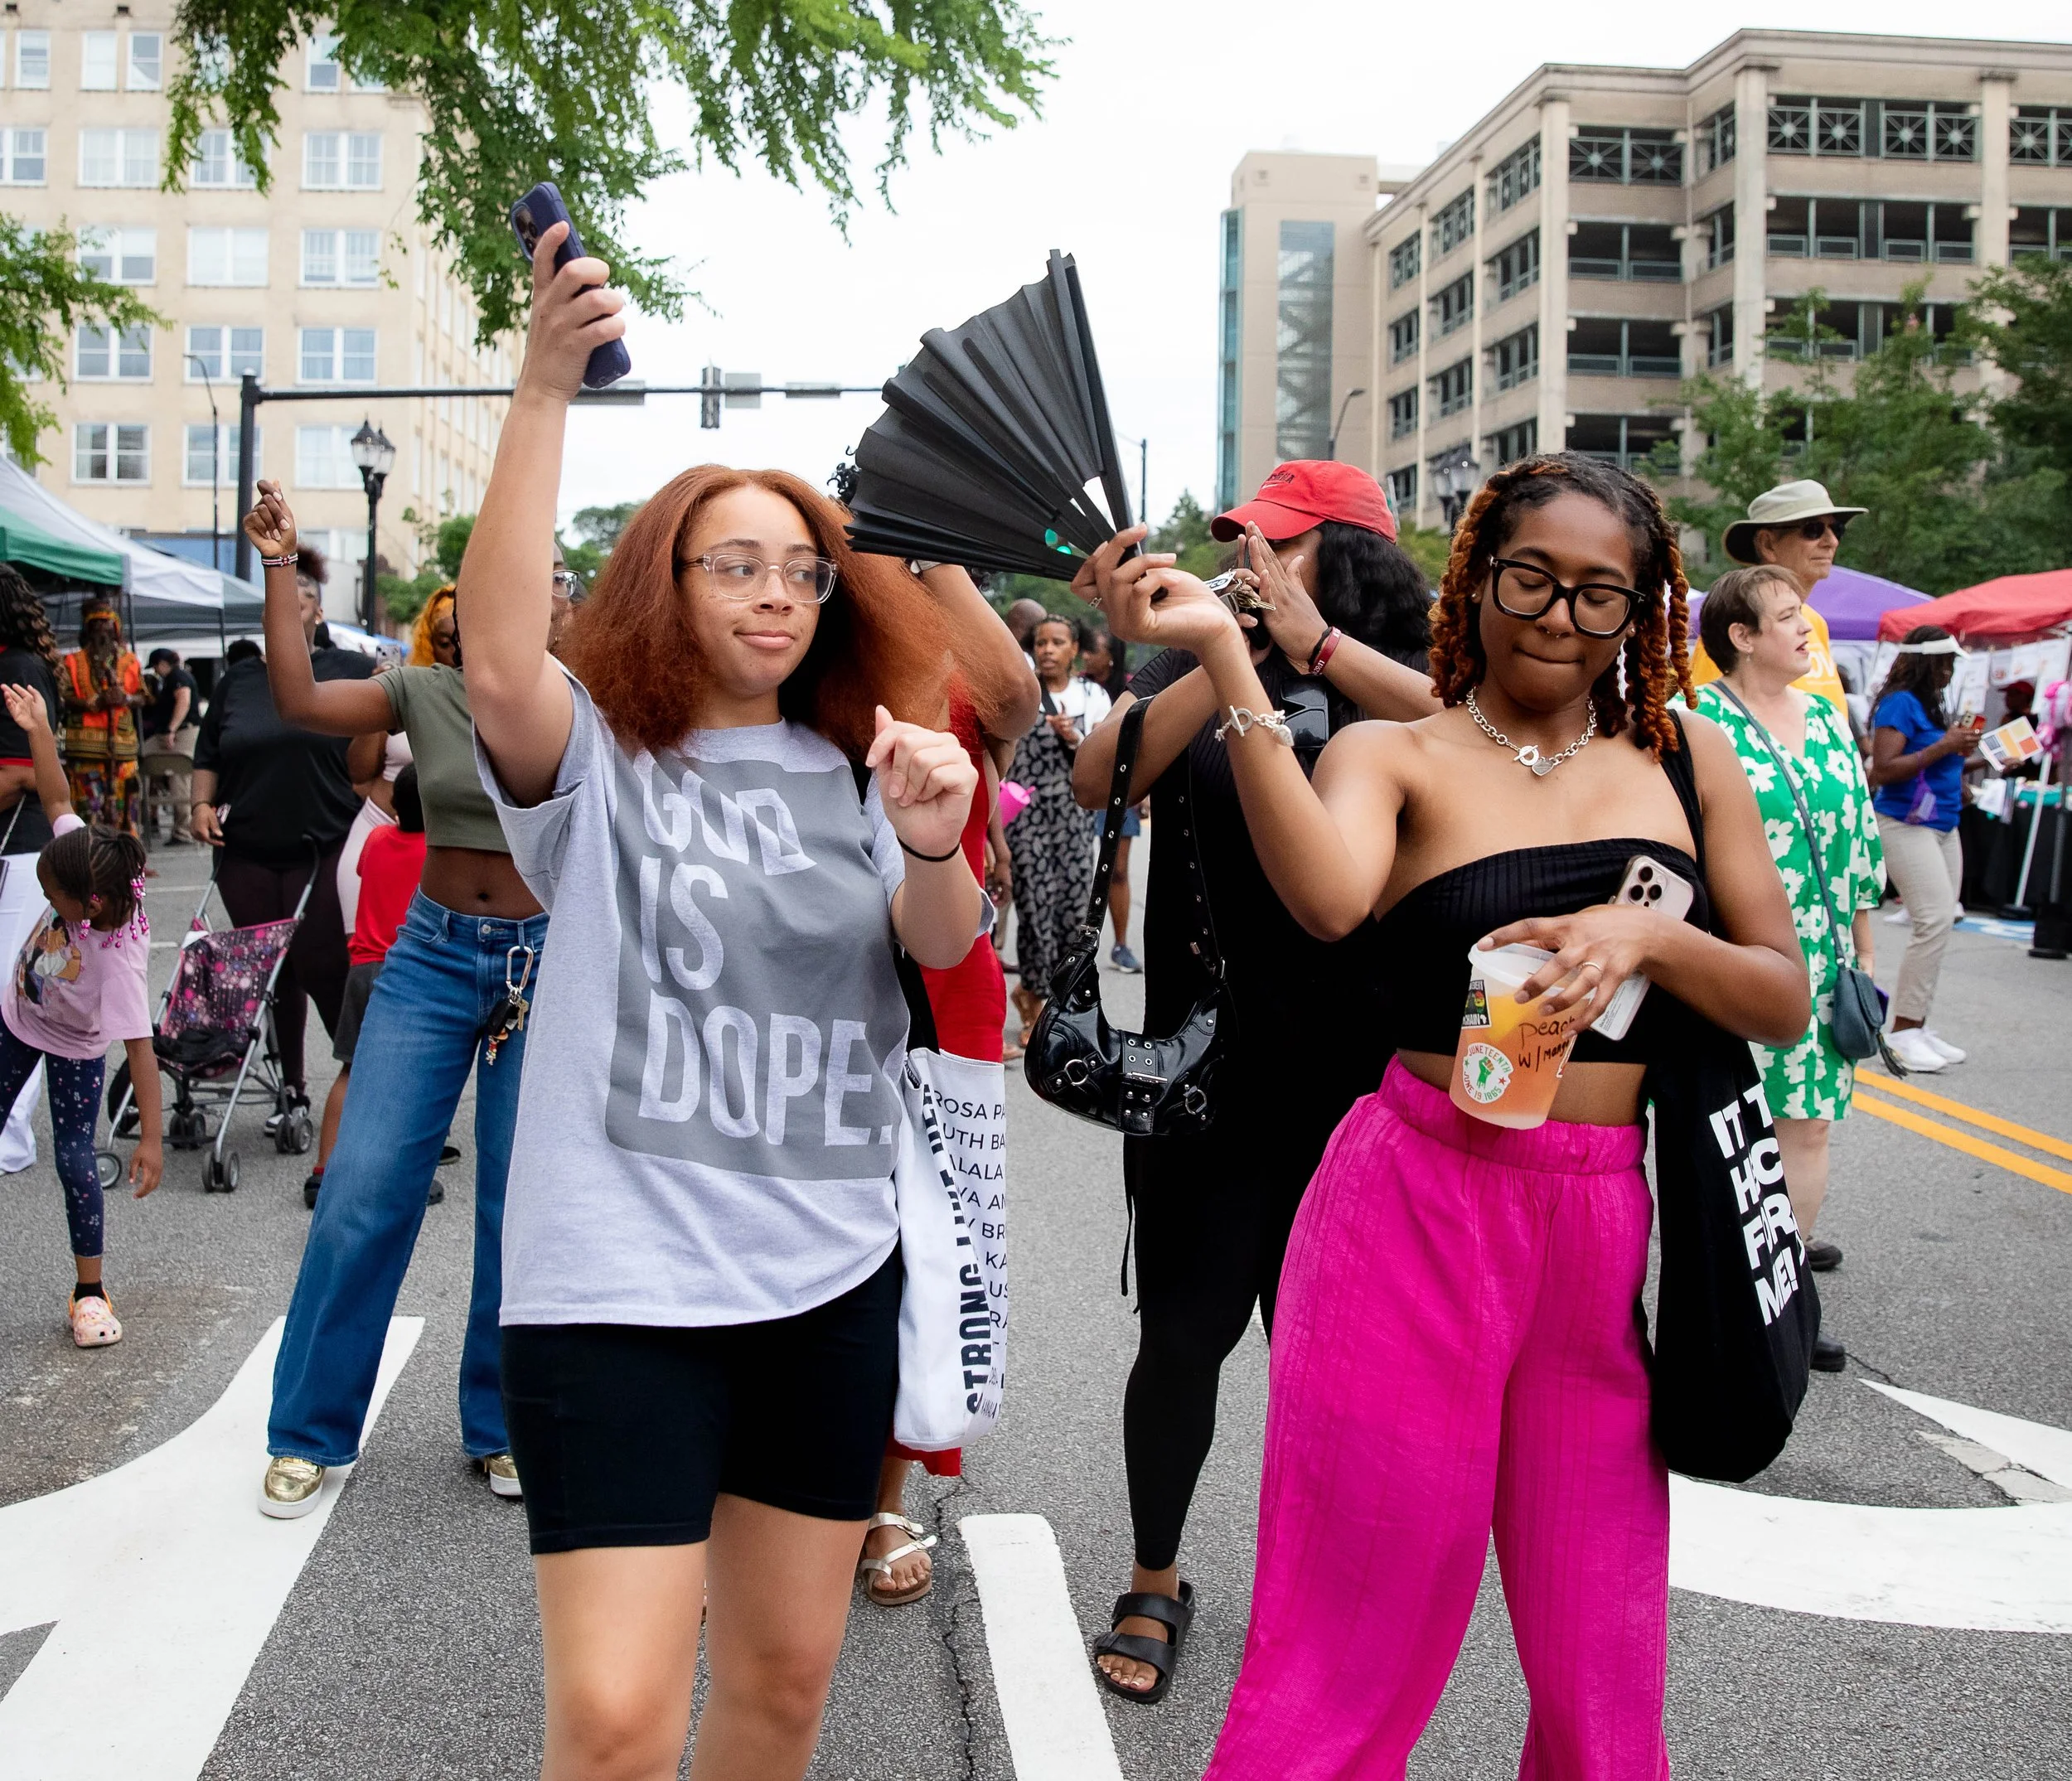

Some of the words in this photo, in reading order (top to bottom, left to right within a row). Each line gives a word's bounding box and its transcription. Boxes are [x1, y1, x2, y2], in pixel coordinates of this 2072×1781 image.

[632, 749, 817, 876] GOD
[639, 855, 729, 990] IS
[638, 989, 893, 1146] DOPE.
[1464, 1072, 1474, 1094] JUNE
[1474, 1091, 1482, 1100] 19
[1469, 1045, 1512, 1073] JUNETEENTH
[934, 1090, 987, 1120] ROSA
